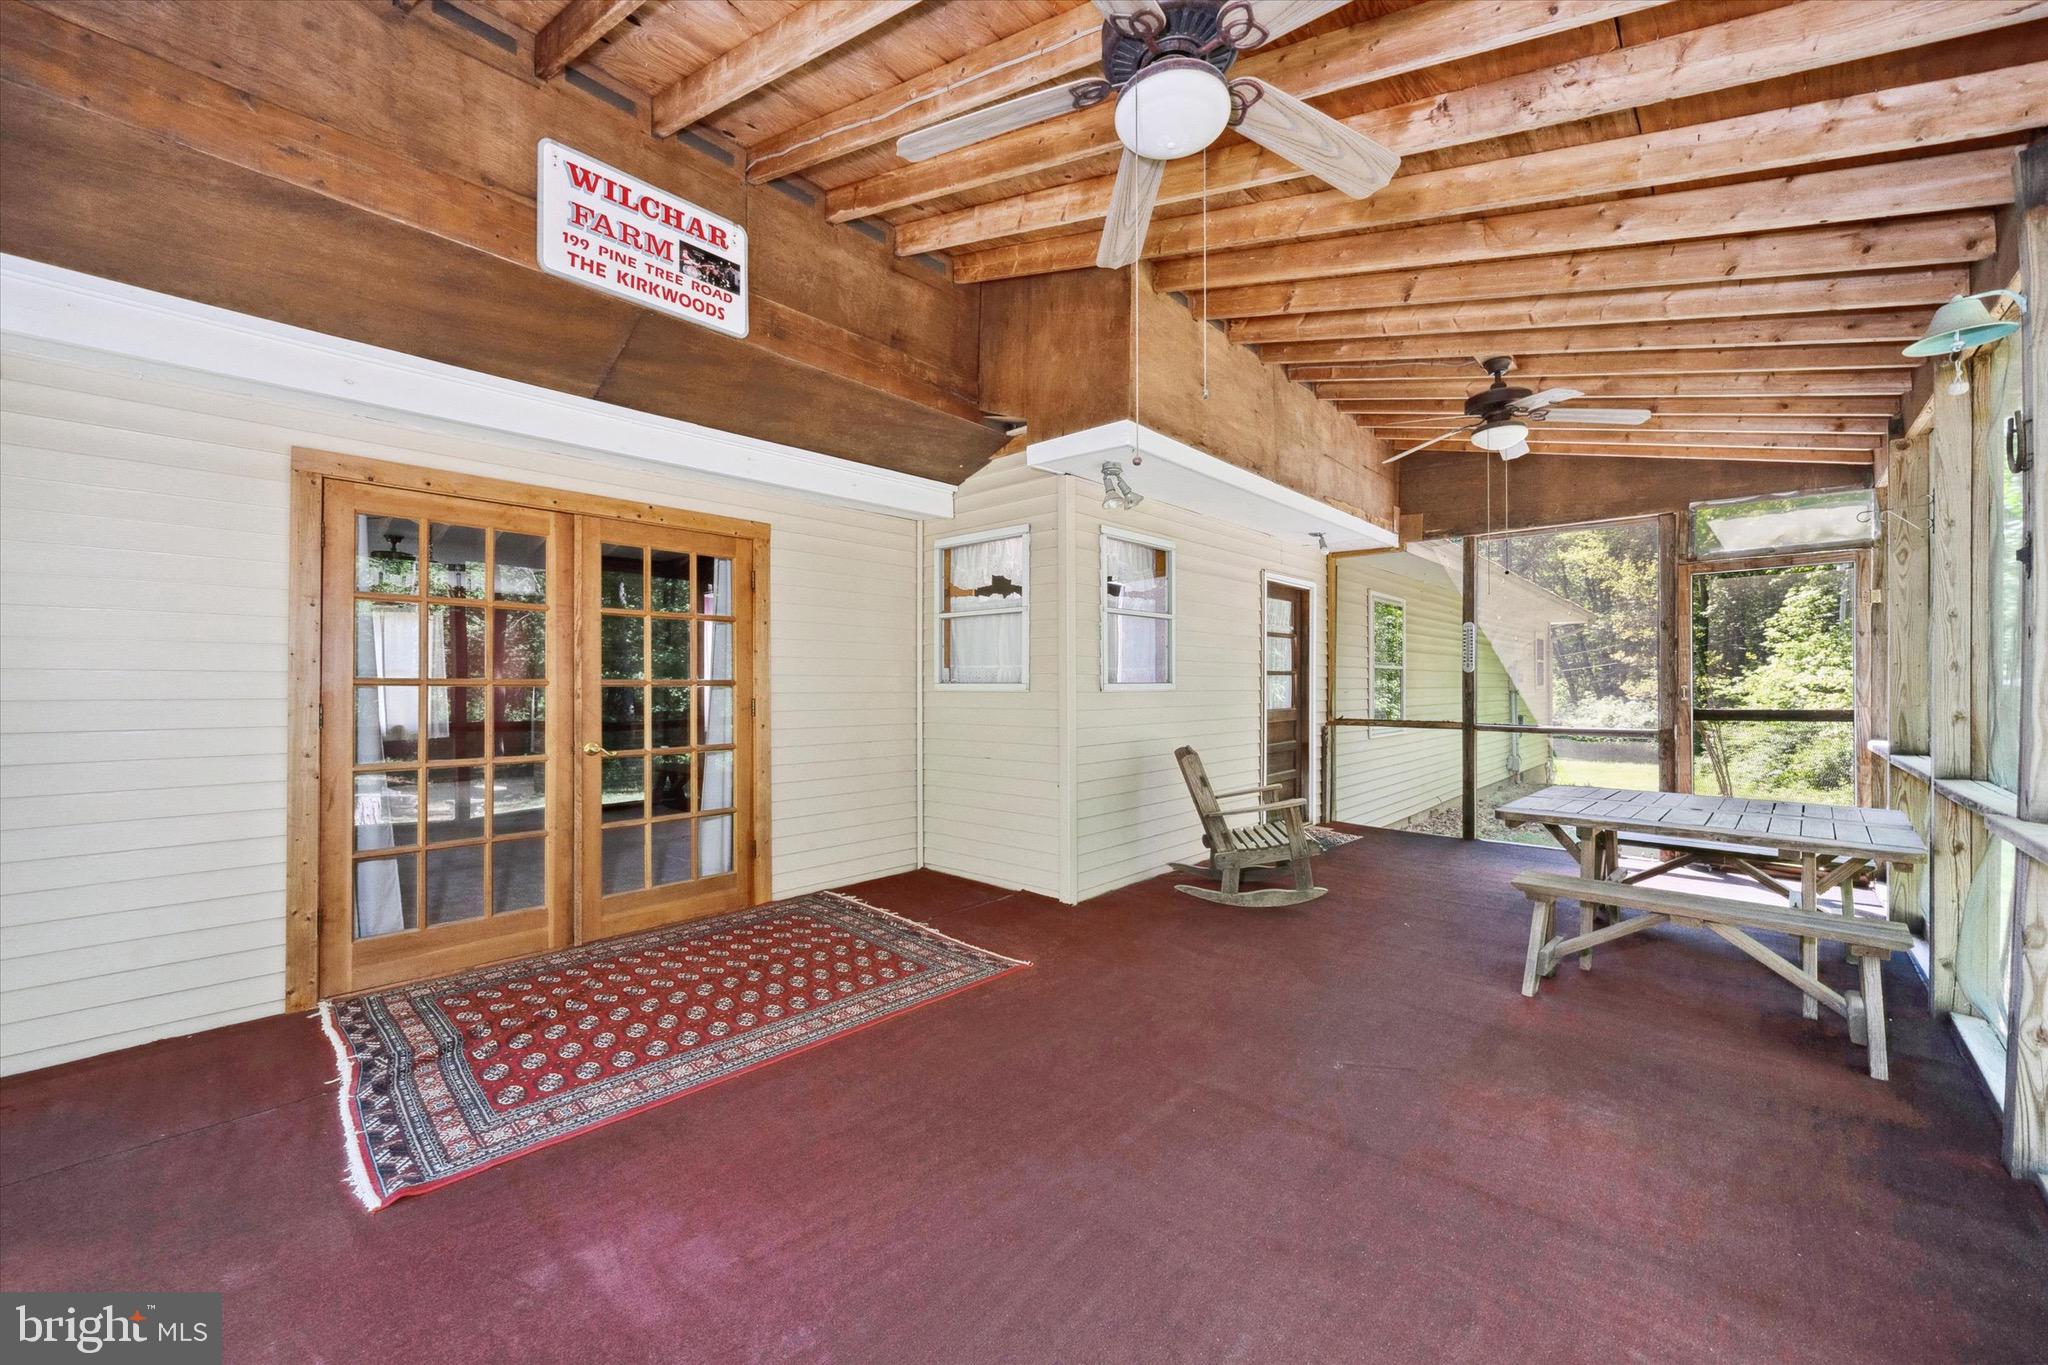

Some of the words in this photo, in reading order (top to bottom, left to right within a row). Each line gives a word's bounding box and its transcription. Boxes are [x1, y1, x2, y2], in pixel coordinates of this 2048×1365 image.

[564, 160, 730, 250] WILCHAR
[569, 201, 674, 263] FARM
[562, 232, 590, 250] 199
[598, 246, 637, 269] PINE
[645, 262, 684, 286] TREE
[691, 280, 733, 304] ROAD
[567, 251, 607, 279] THE
[616, 270, 725, 321] KIRKWOODS
